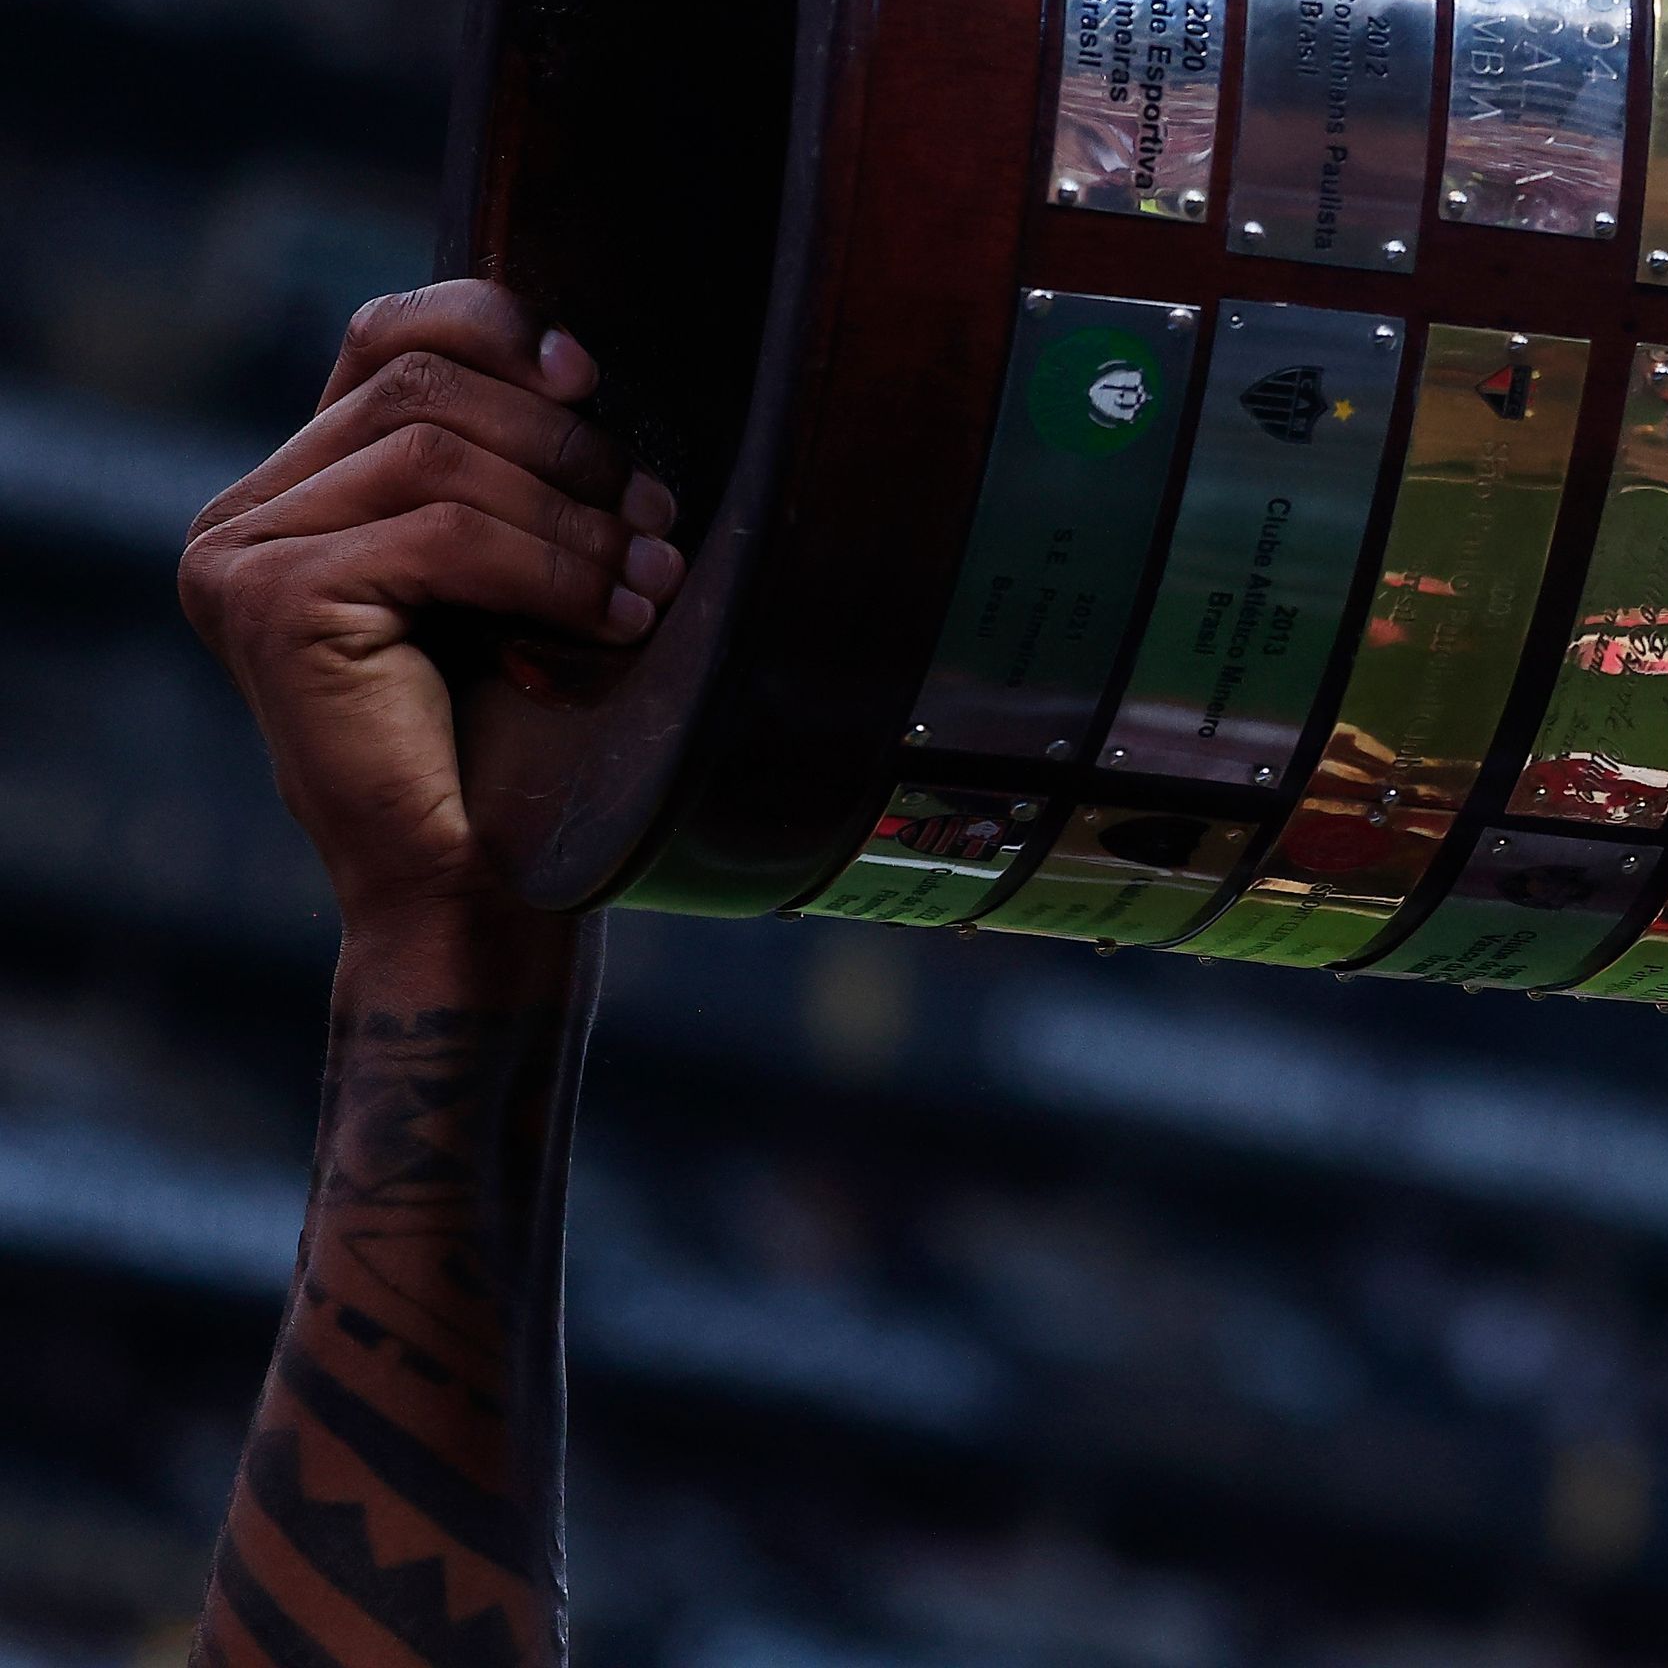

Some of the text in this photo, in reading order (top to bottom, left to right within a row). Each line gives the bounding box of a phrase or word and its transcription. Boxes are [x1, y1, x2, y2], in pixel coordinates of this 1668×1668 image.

[1182, 1, 1210, 72] 2020
[1296, 0, 1323, 77] Brasil
[1365, 15, 1391, 78] 2012
[1135, 44, 1172, 189] Esportiva
[1314, 145, 1348, 250] Paulista
[1253, 497, 1291, 568] Clube
[1194, 590, 1234, 657] Brasil
[1263, 604, 1299, 656] 2013
[1198, 665, 1244, 739] Mineiro
